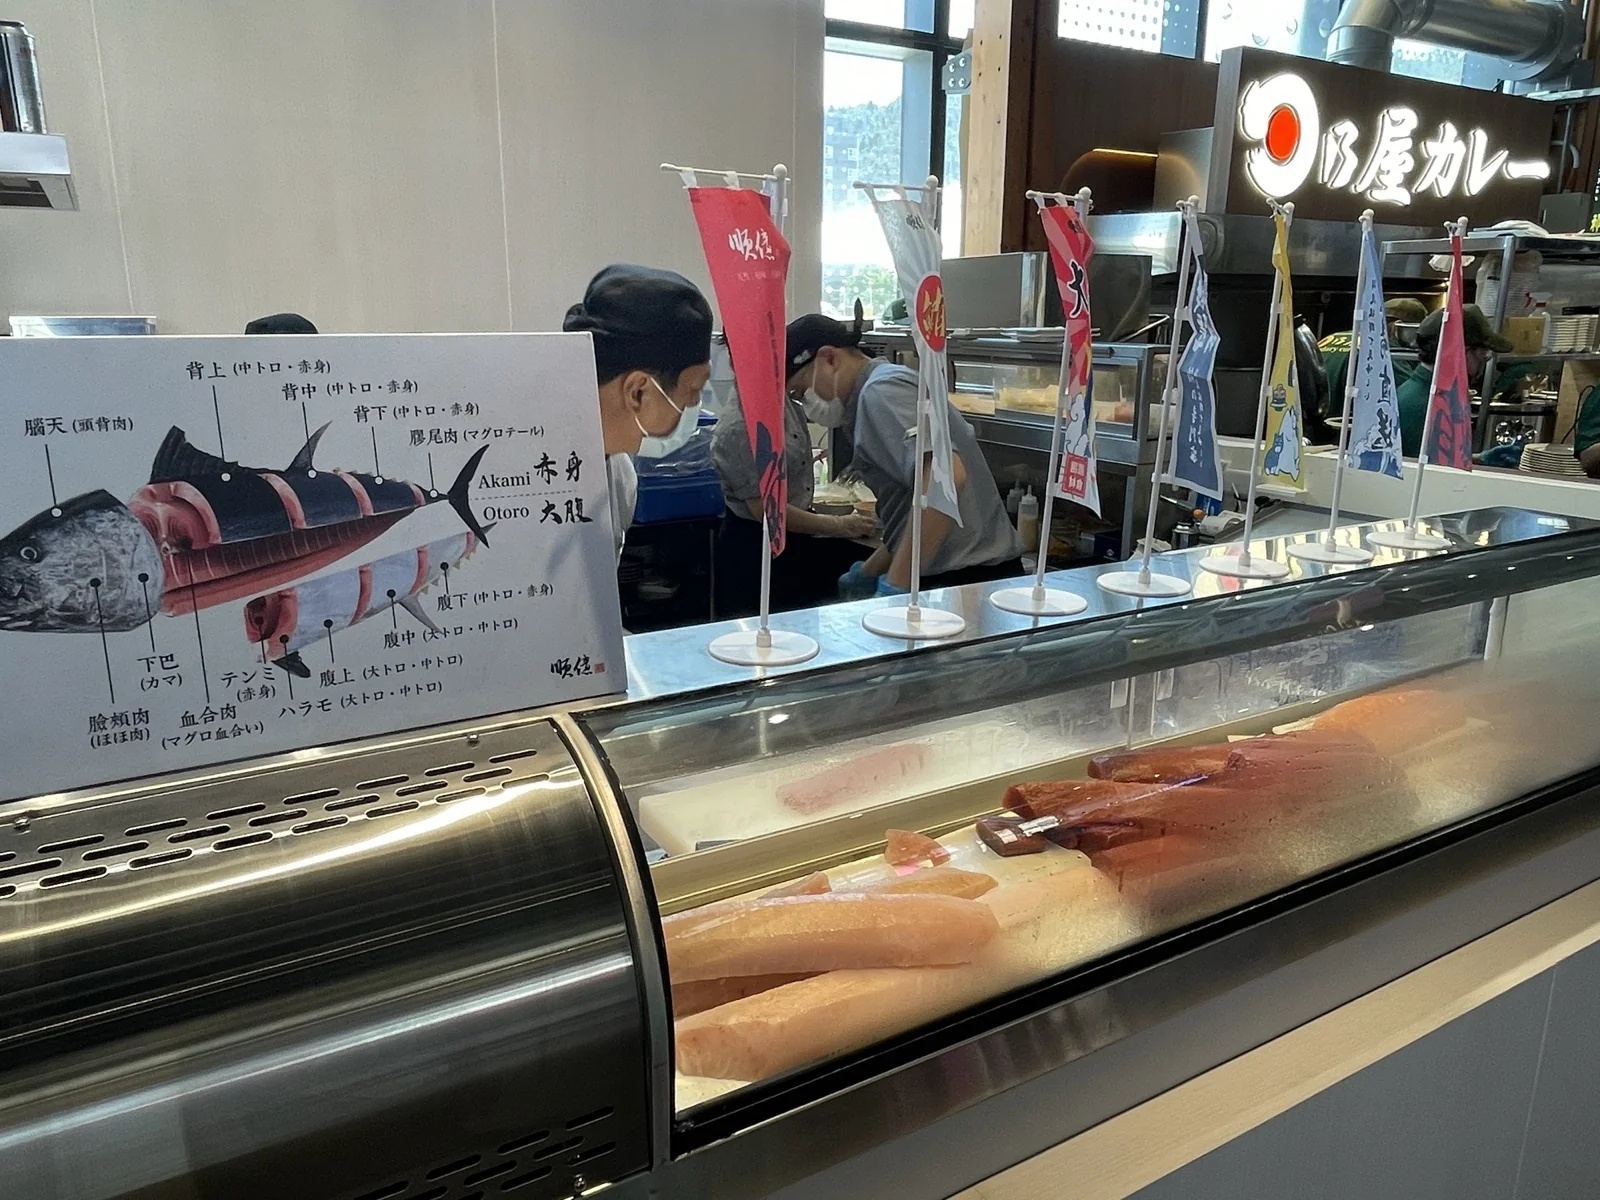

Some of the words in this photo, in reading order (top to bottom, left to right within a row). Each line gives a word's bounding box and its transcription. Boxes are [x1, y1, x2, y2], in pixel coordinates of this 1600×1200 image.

[186, 361, 227, 380] 背上
[281, 382, 317, 401] 背中
[353, 404, 387, 423] 背下
[478, 471, 531, 489] Akami
[483, 506, 530, 521] Otoro
[136, 653, 180, 673] 下巴
[140, 673, 183, 692] (カマ)
[220, 666, 276, 688] テンミ
[319, 667, 356, 689] 腹上
[178, 703, 237, 729] 血合肉
[278, 698, 332, 719] ハラモ
